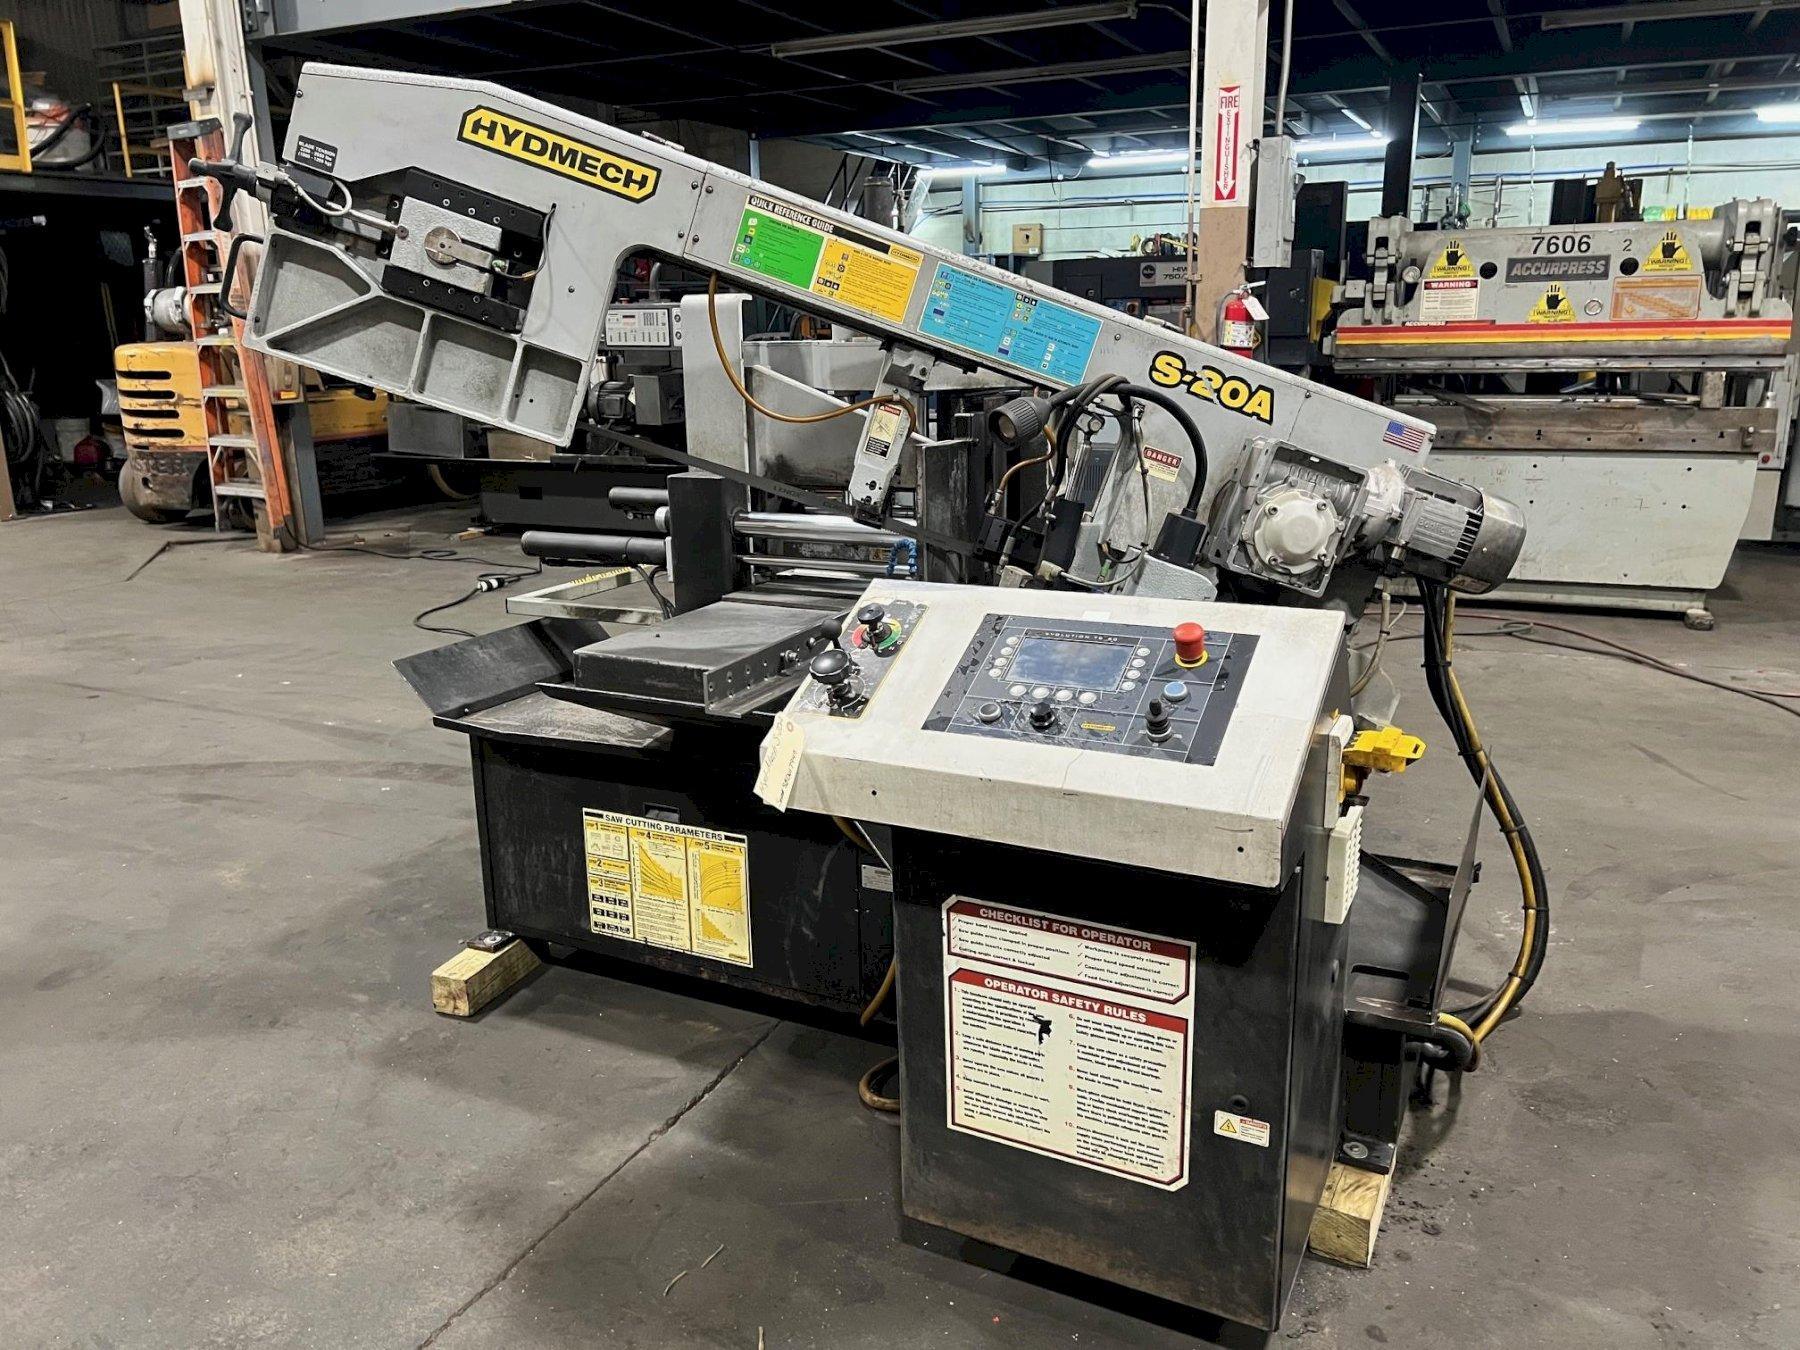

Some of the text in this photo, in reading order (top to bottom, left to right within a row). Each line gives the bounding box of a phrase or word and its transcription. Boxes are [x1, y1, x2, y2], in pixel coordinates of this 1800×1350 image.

[1220, 95, 1239, 109] FIRE
[316, 146, 336, 157] TENSION
[470, 116, 649, 192] HYDMECH
[1223, 109, 1232, 190] EXTINGUISHER
[751, 197, 774, 213] QUICK
[774, 203, 811, 226] REFERENCE
[811, 219, 835, 233] GUIDE
[1532, 234, 1592, 255] 7606
[1622, 238, 1633, 252] 2
[1511, 260, 1606, 277] ACCURPRESS
[1149, 350, 1274, 425] S-20A
[1146, 450, 1179, 466] DANGER
[595, 822, 599, 830] 1
[605, 814, 623, 824] SAW
[625, 818, 662, 831] CUTTING
[664, 824, 723, 841] PARAMETERS
[646, 831, 652, 840] 4
[704, 841, 710, 850] 5
[597, 859, 602, 867] 2
[599, 879, 604, 887] 3
[979, 908, 1152, 951] CHECKLIST FOR OPERATOR
[984, 978, 1049, 1001] OPERATOR
[1051, 992, 1101, 1013] SAFETY
[1103, 1003, 1147, 1023] RULES
